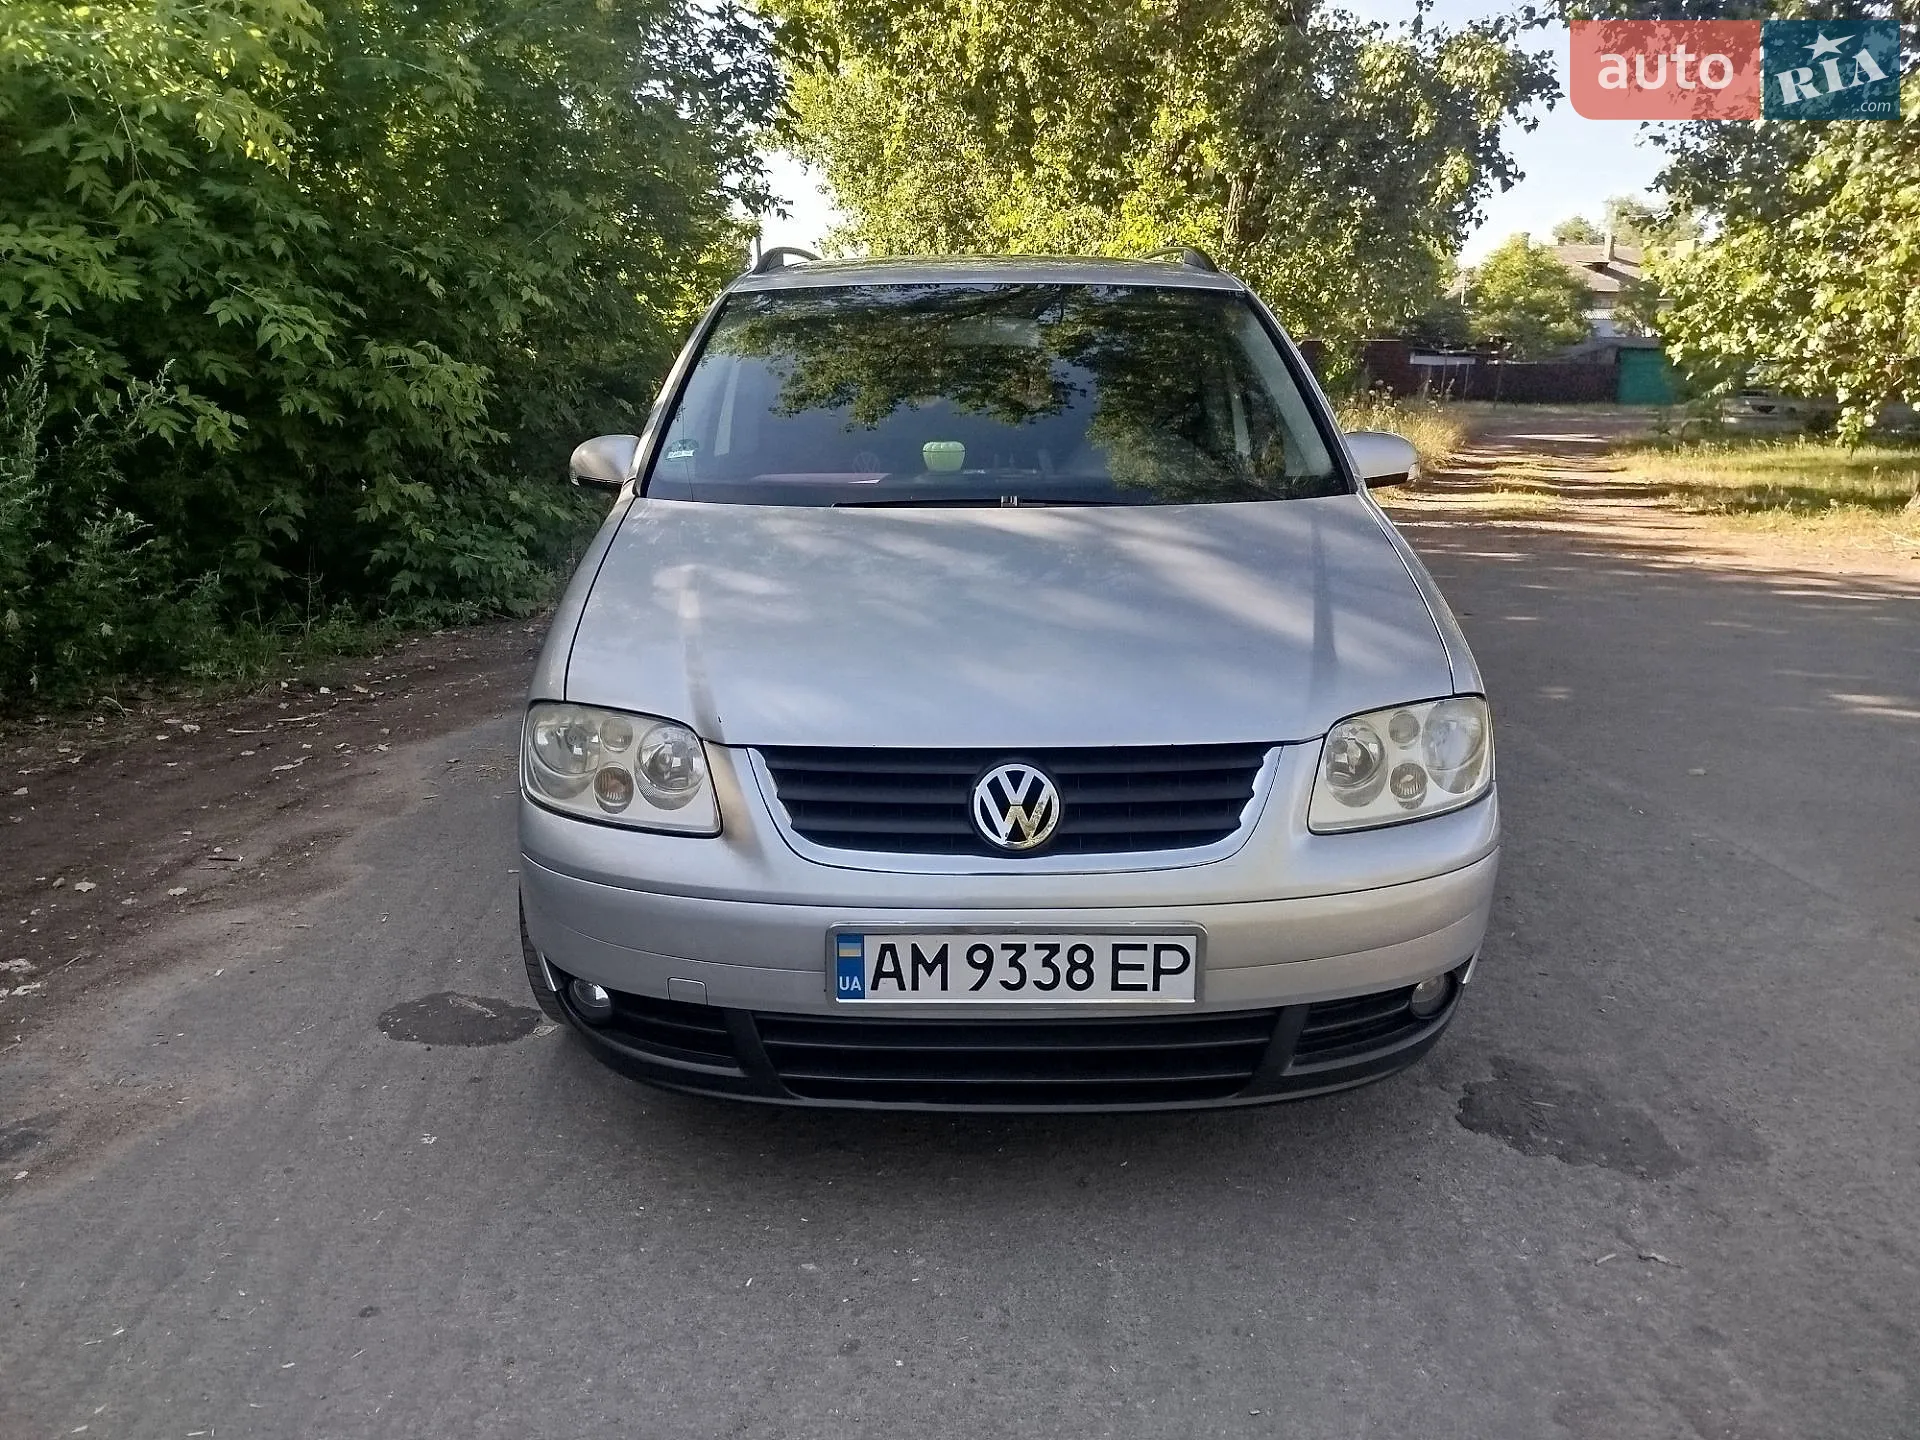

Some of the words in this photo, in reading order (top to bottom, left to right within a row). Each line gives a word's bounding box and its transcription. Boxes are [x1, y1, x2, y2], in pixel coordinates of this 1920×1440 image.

[838, 975, 863, 992] UA
[870, 942, 949, 992] AM
[966, 942, 1096, 992] 9338
[1111, 942, 1192, 992] EP
